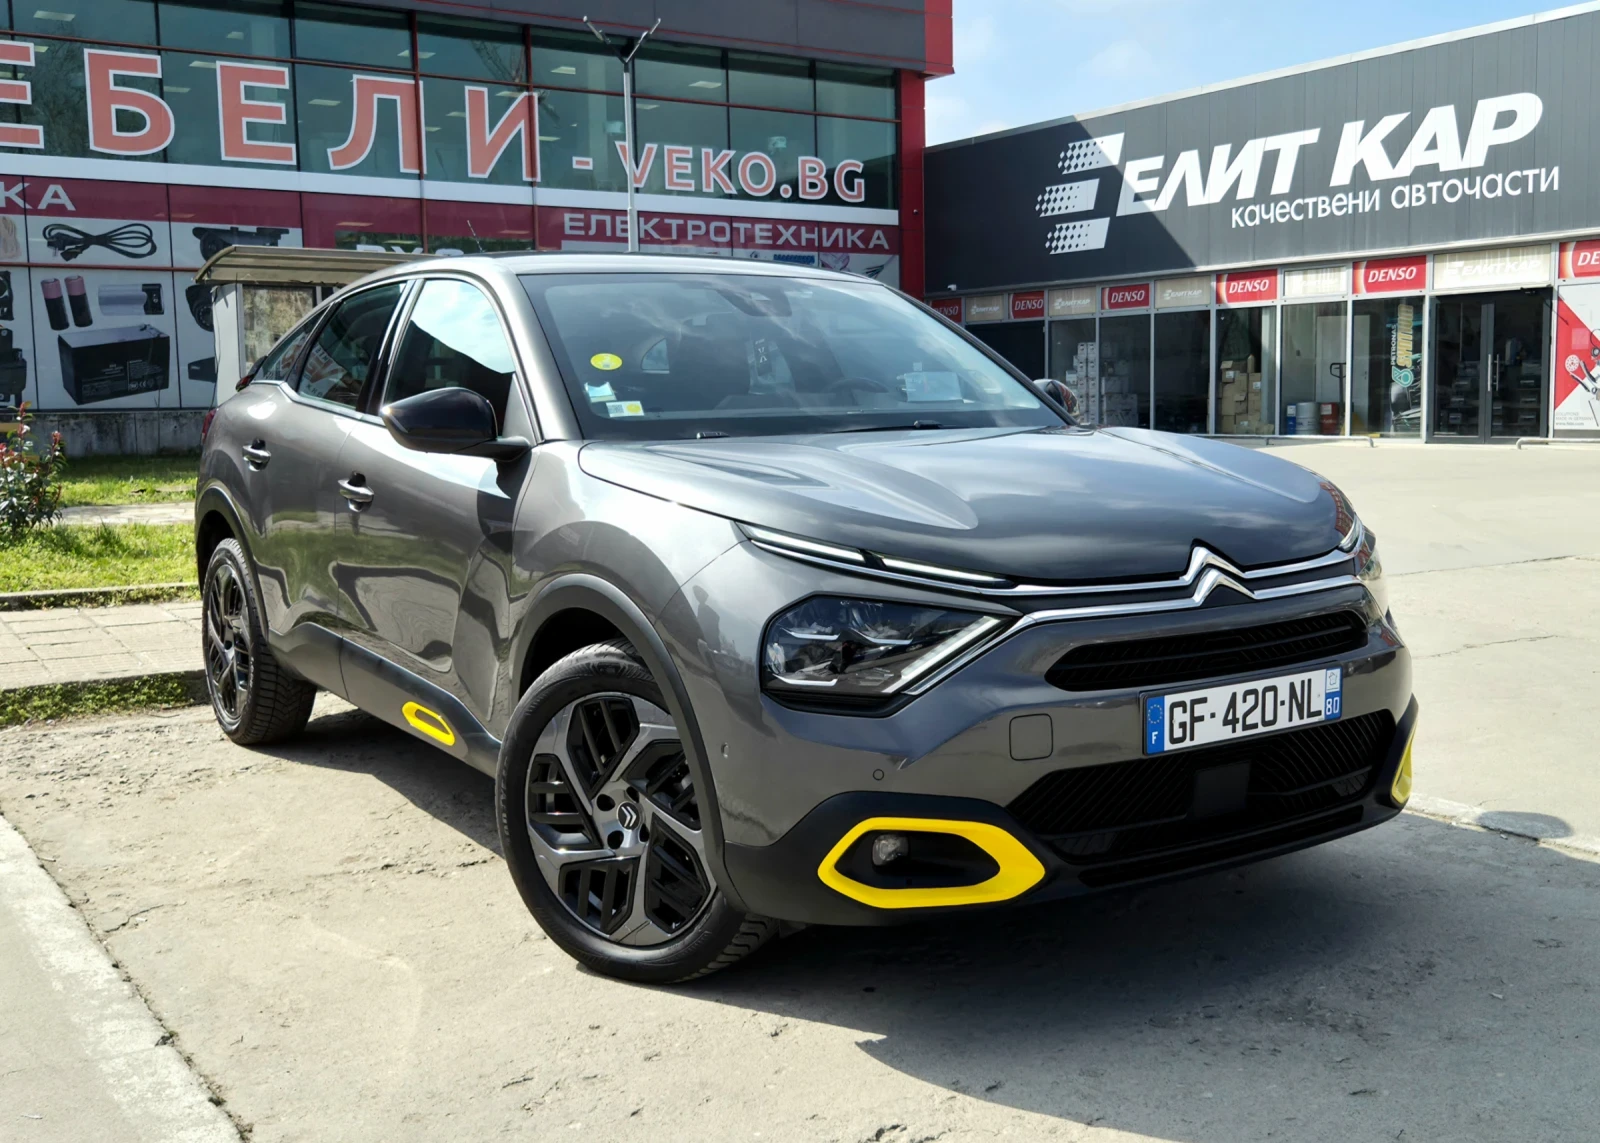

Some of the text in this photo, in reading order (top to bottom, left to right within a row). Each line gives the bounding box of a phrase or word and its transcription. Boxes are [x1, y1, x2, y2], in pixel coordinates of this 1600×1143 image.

[1116, 92, 1544, 217] ЕЛИТ КАР
[614, 140, 866, 203] VEKO.BG
[0, 181, 76, 211] КА
[1232, 166, 1560, 229] качествени авточасти
[563, 212, 890, 250] ЕЛЕКТРОТЕХНИКА
[1228, 279, 1269, 294] DENSO
[1367, 266, 1417, 283] DENSO
[1014, 299, 1044, 311] DENSO
[1110, 290, 1145, 303] DENSO
[1169, 678, 1322, 745] GF-420-NL
[1325, 697, 1340, 715] 80
[1151, 731, 1158, 744] F
